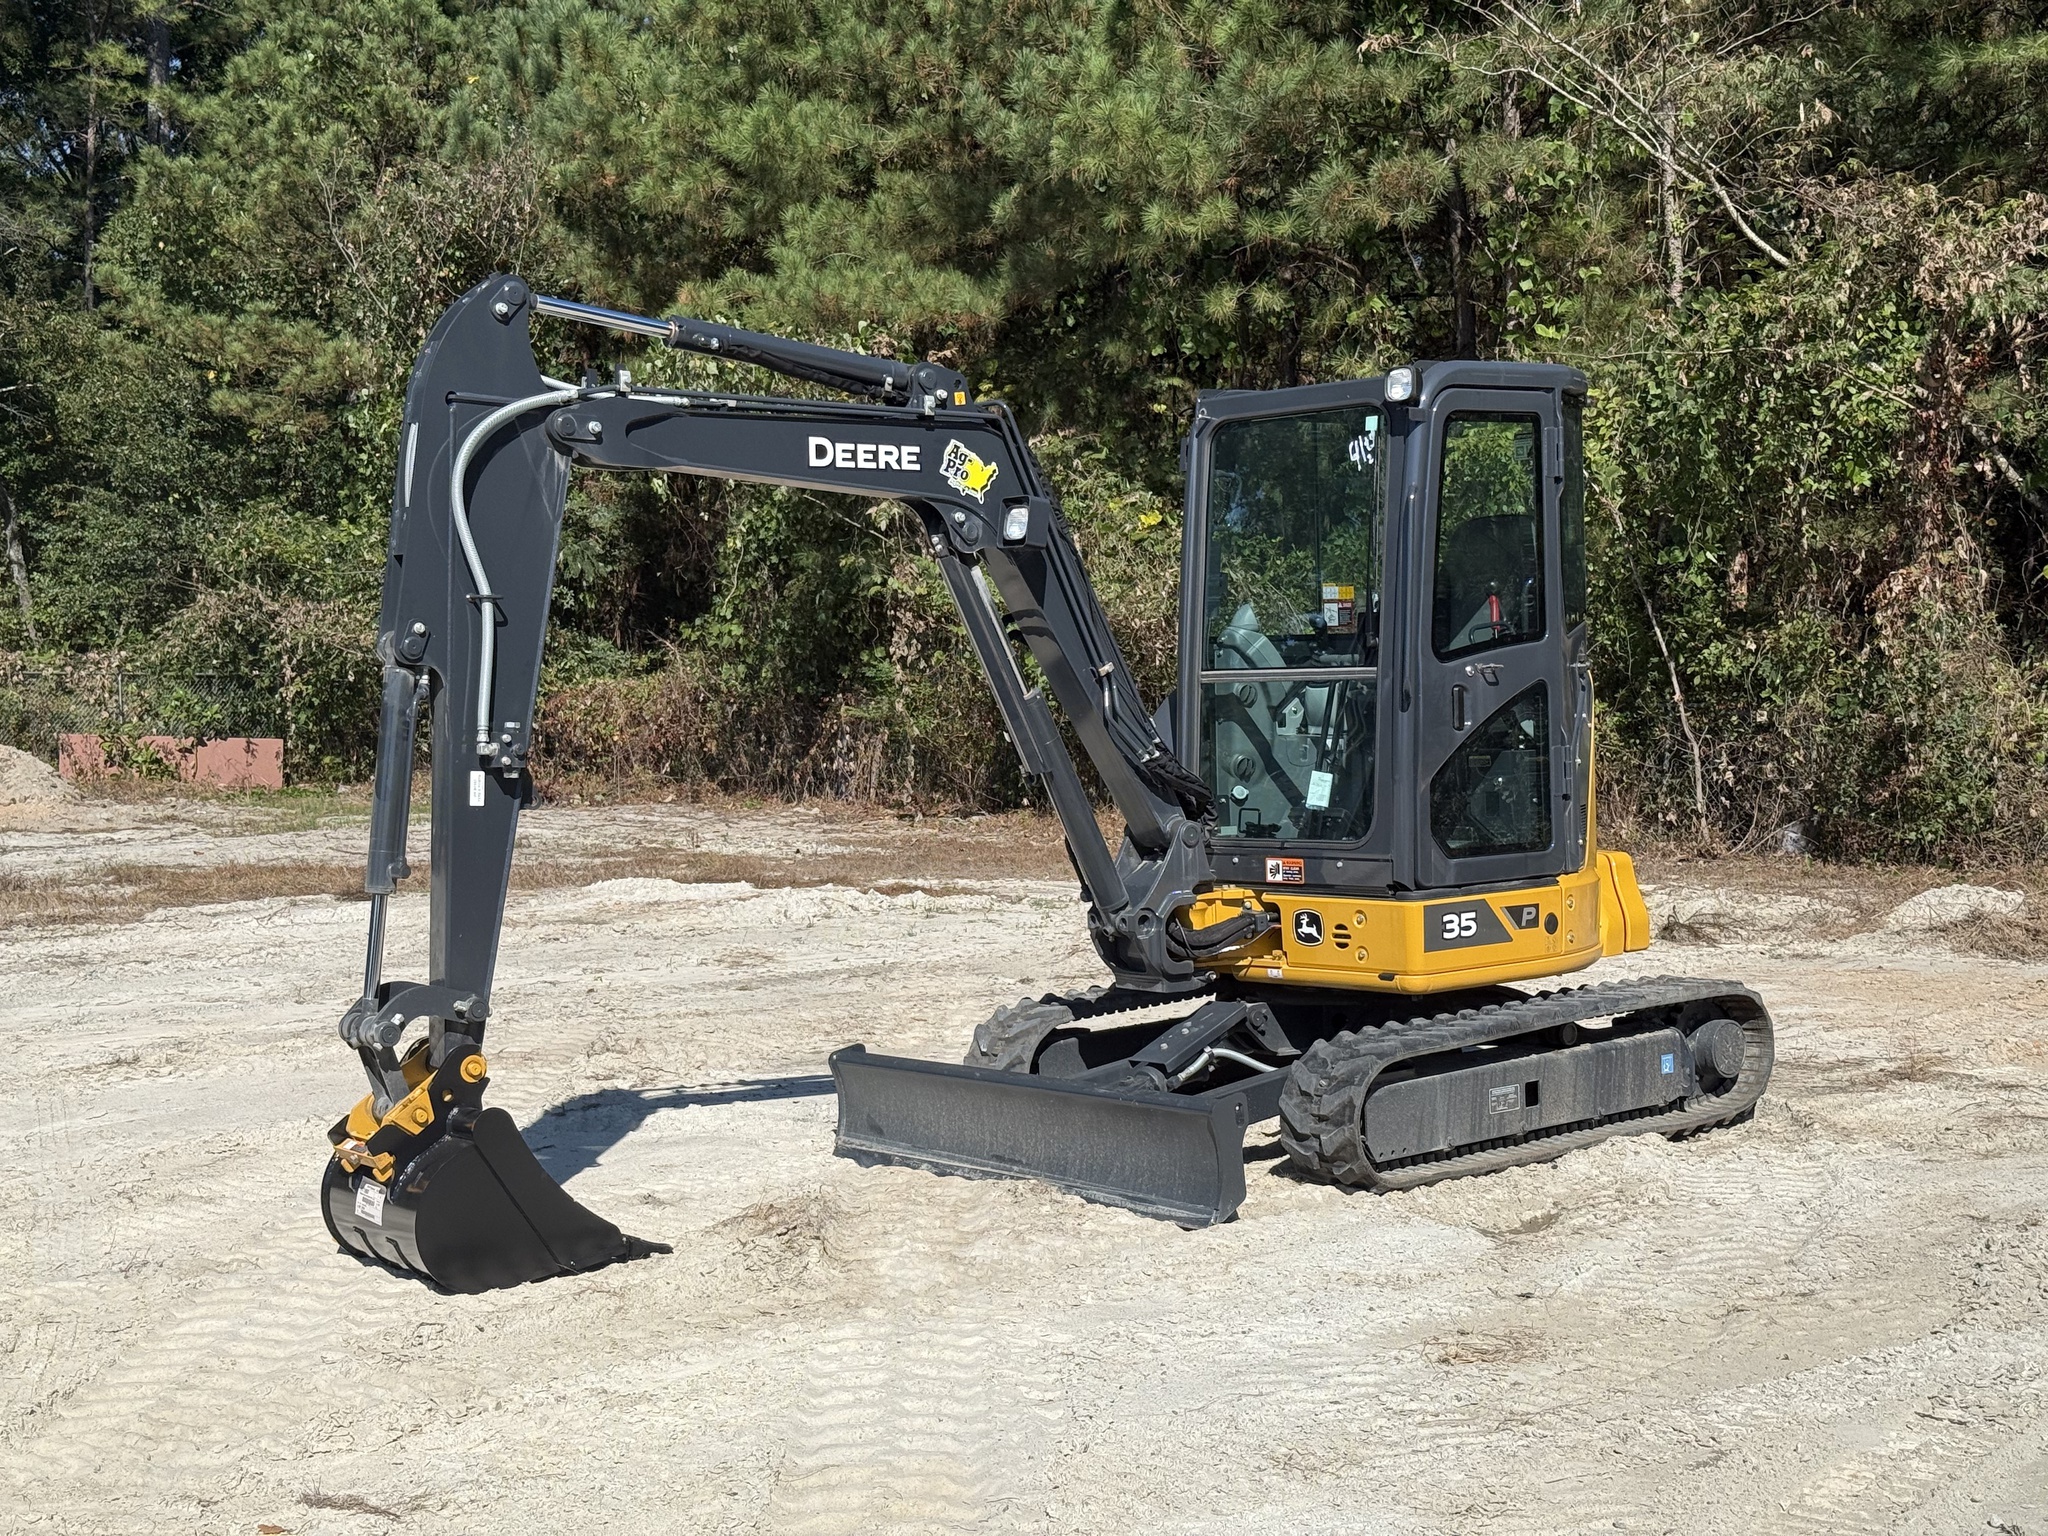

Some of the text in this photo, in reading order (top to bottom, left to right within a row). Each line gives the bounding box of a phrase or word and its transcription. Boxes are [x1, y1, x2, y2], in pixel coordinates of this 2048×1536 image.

[808, 436, 921, 471] DEERE
[948, 444, 973, 467] Ag-
[944, 458, 969, 480] Pro
[1441, 911, 1478, 940] 35
[1521, 907, 1537, 927] P
